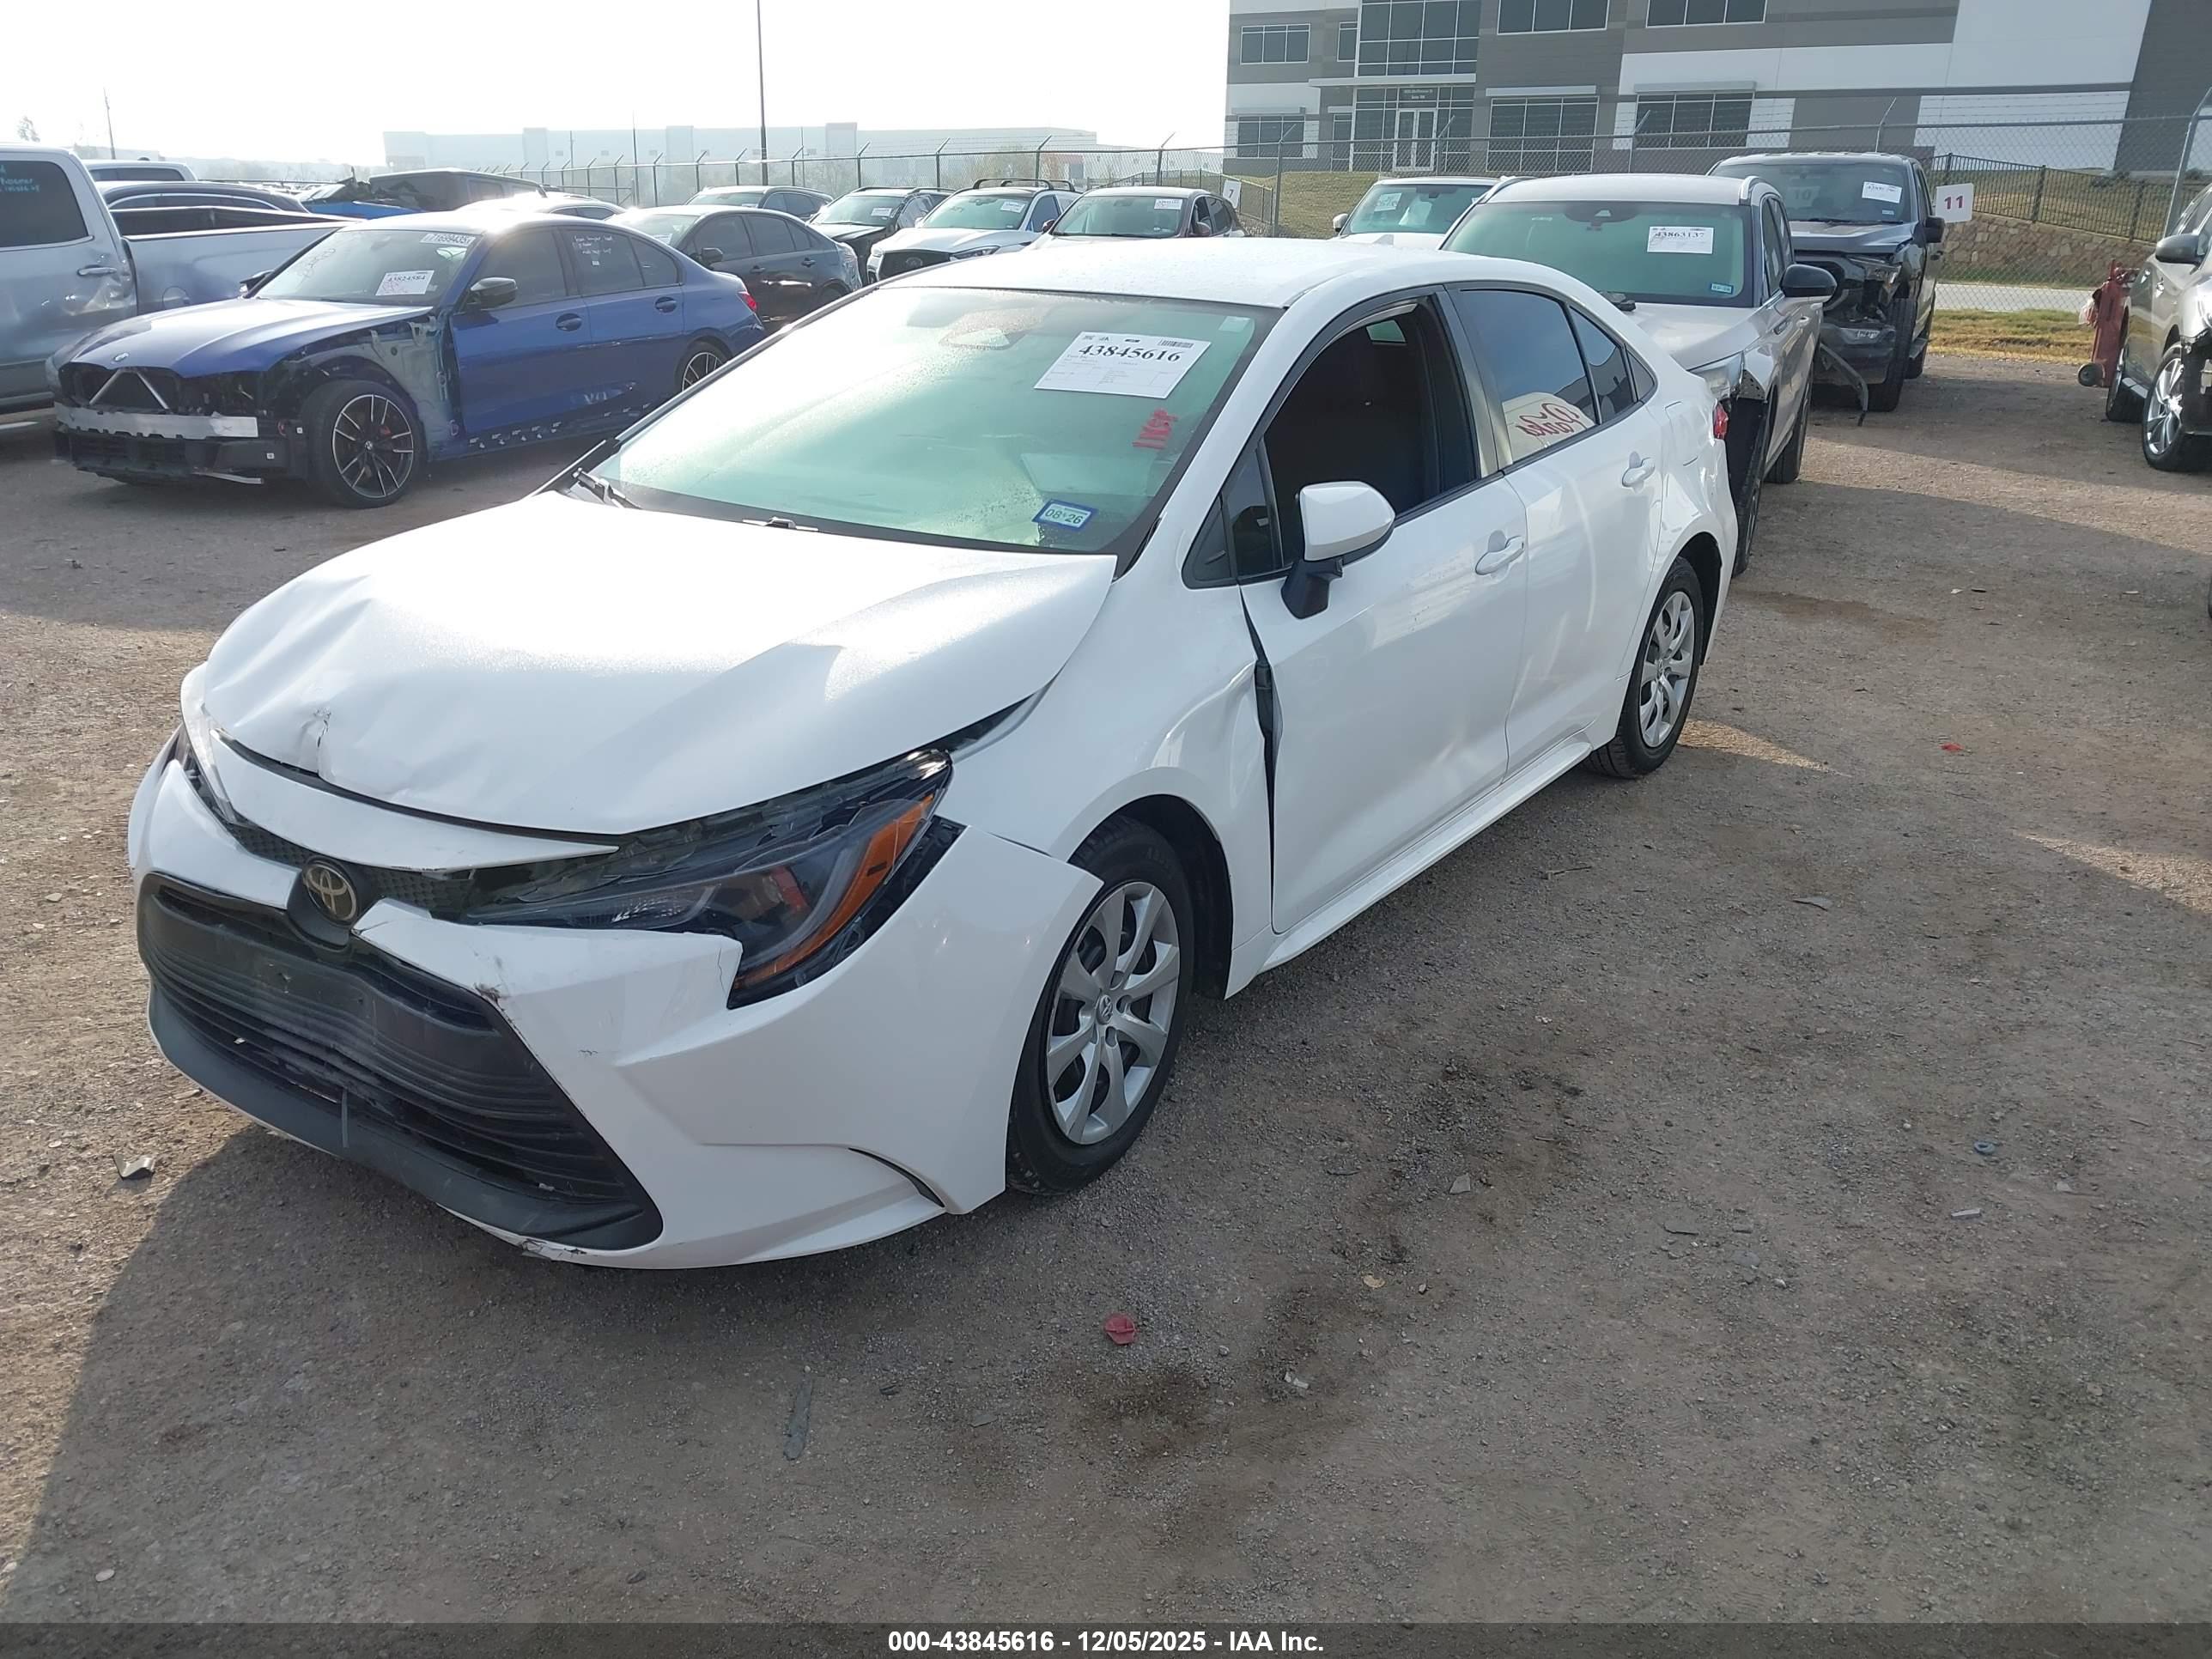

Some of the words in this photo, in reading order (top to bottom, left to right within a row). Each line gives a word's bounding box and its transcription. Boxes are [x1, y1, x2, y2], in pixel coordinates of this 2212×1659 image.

[1229, 188, 1234, 198] 7
[1944, 195, 1963, 210] 11
[1079, 343, 1182, 362] 43845616
[1045, 508, 1062, 520] 08
[1065, 514, 1083, 525] 26
